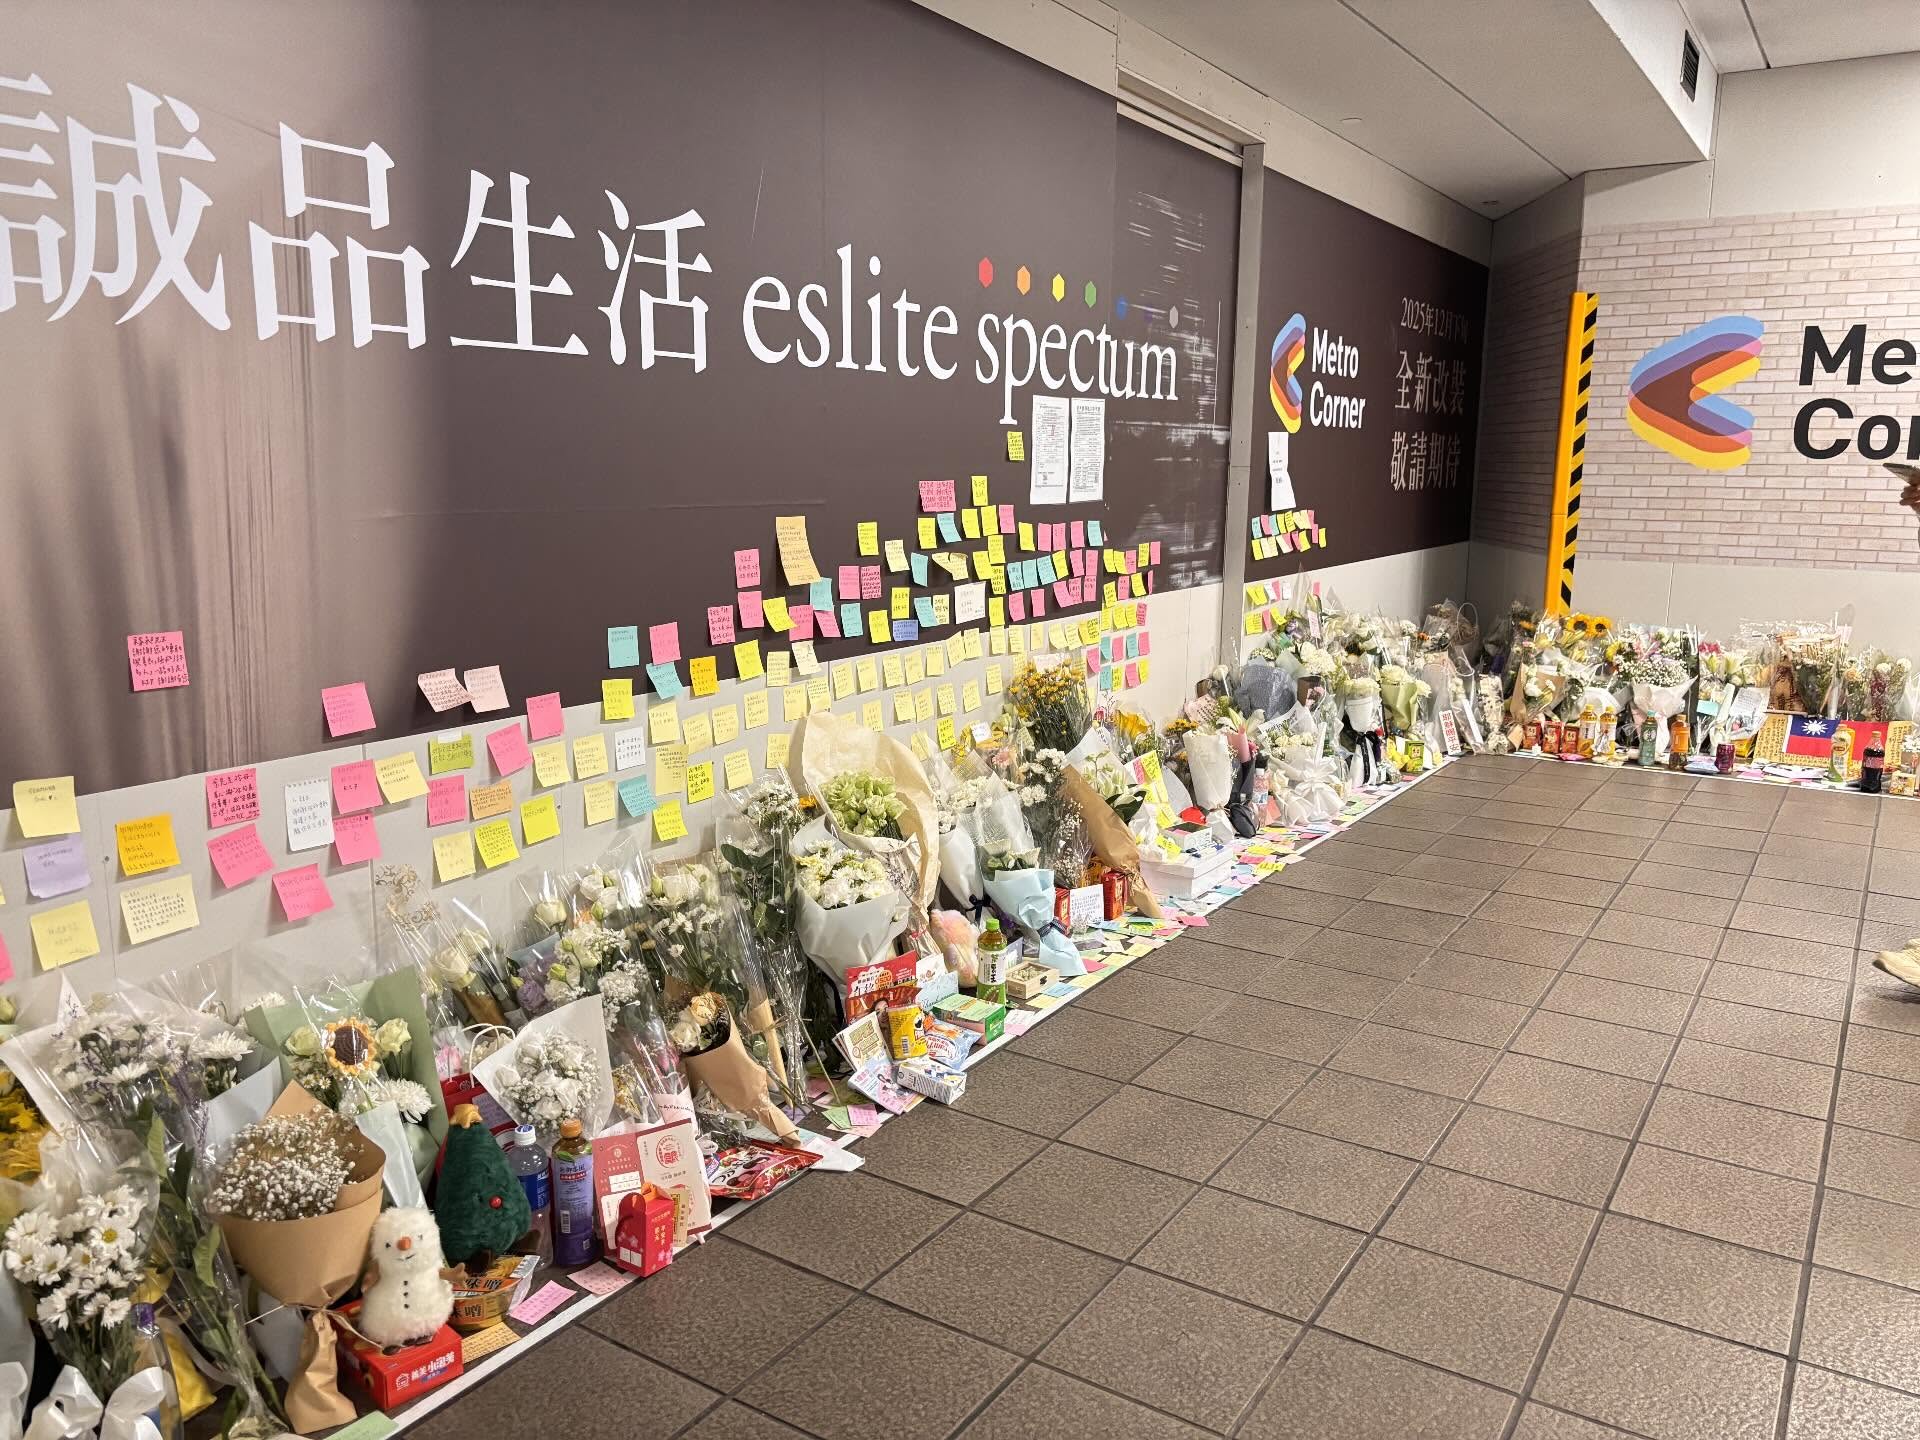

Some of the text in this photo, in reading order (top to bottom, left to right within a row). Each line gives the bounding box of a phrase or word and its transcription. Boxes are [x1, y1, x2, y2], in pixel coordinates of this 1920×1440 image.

[0, 72, 713, 374] 誠品生活
[743, 243, 959, 380] eslite
[1311, 327, 1360, 379] Metro
[1394, 350, 1466, 415] 全新改裝
[1309, 380, 1366, 429] Corner
[1390, 431, 1462, 492] 敬請期待
